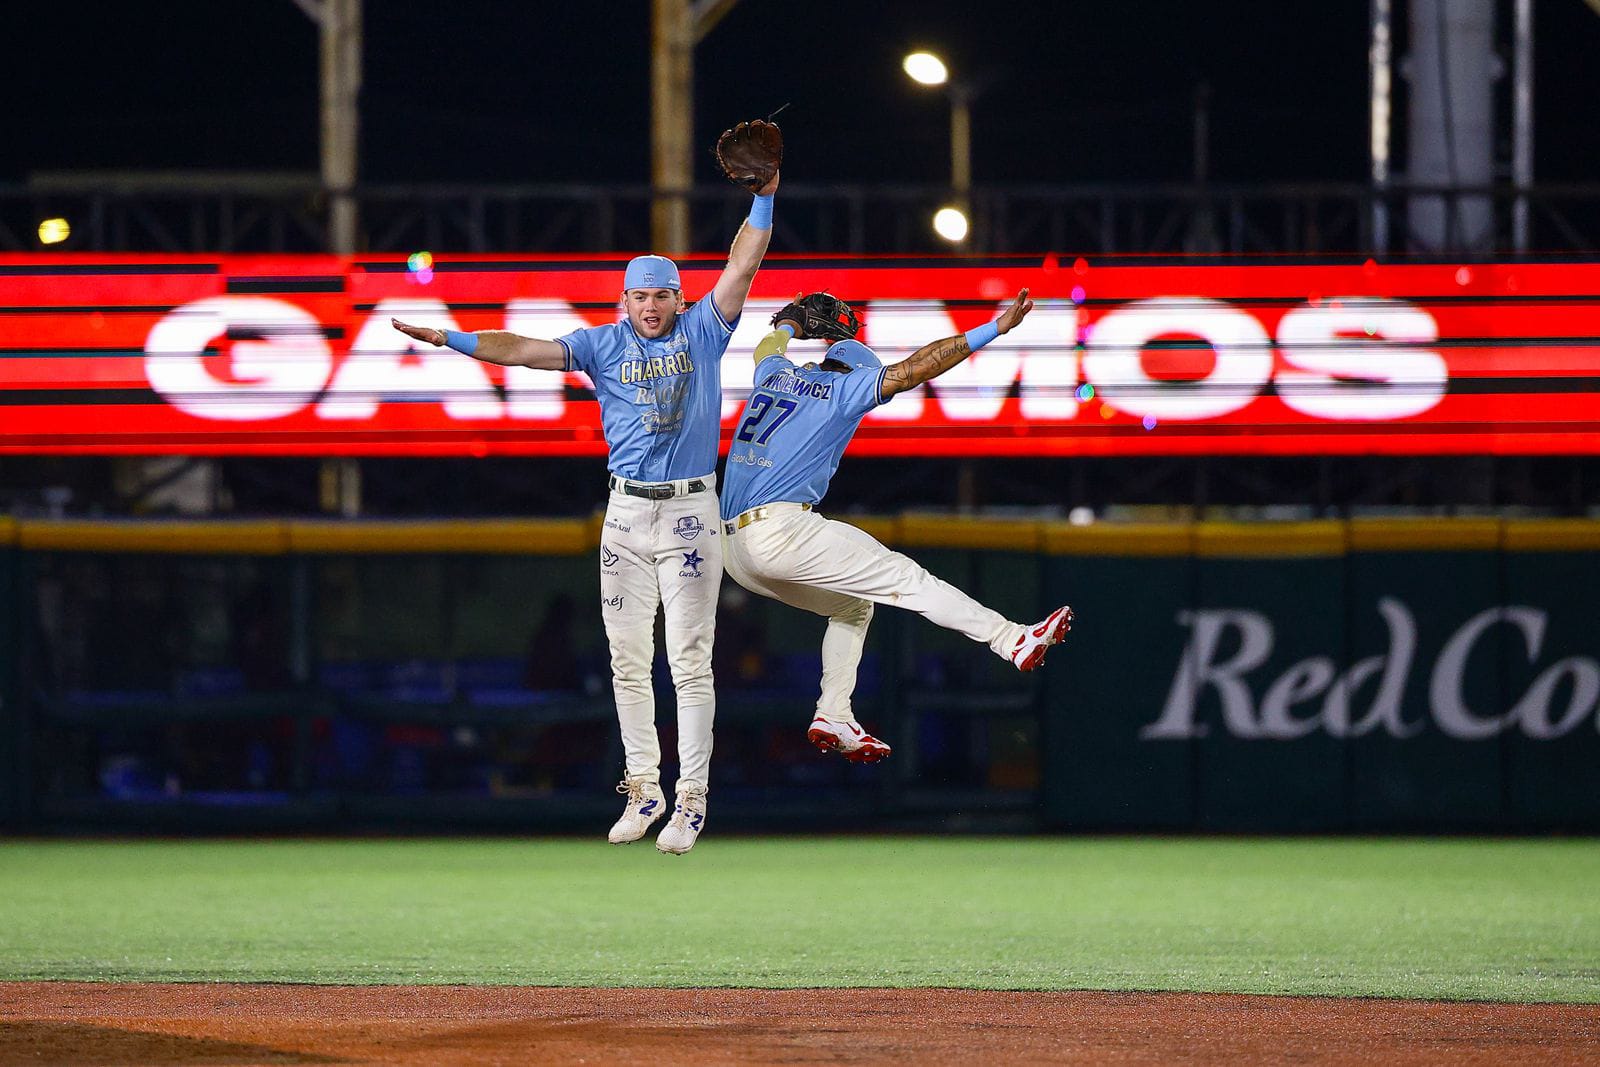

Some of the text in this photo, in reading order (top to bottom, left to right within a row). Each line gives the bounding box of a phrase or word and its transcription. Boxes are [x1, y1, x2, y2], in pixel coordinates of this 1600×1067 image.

[736, 391, 799, 448] 27
[1139, 596, 1600, 741] Red Co
